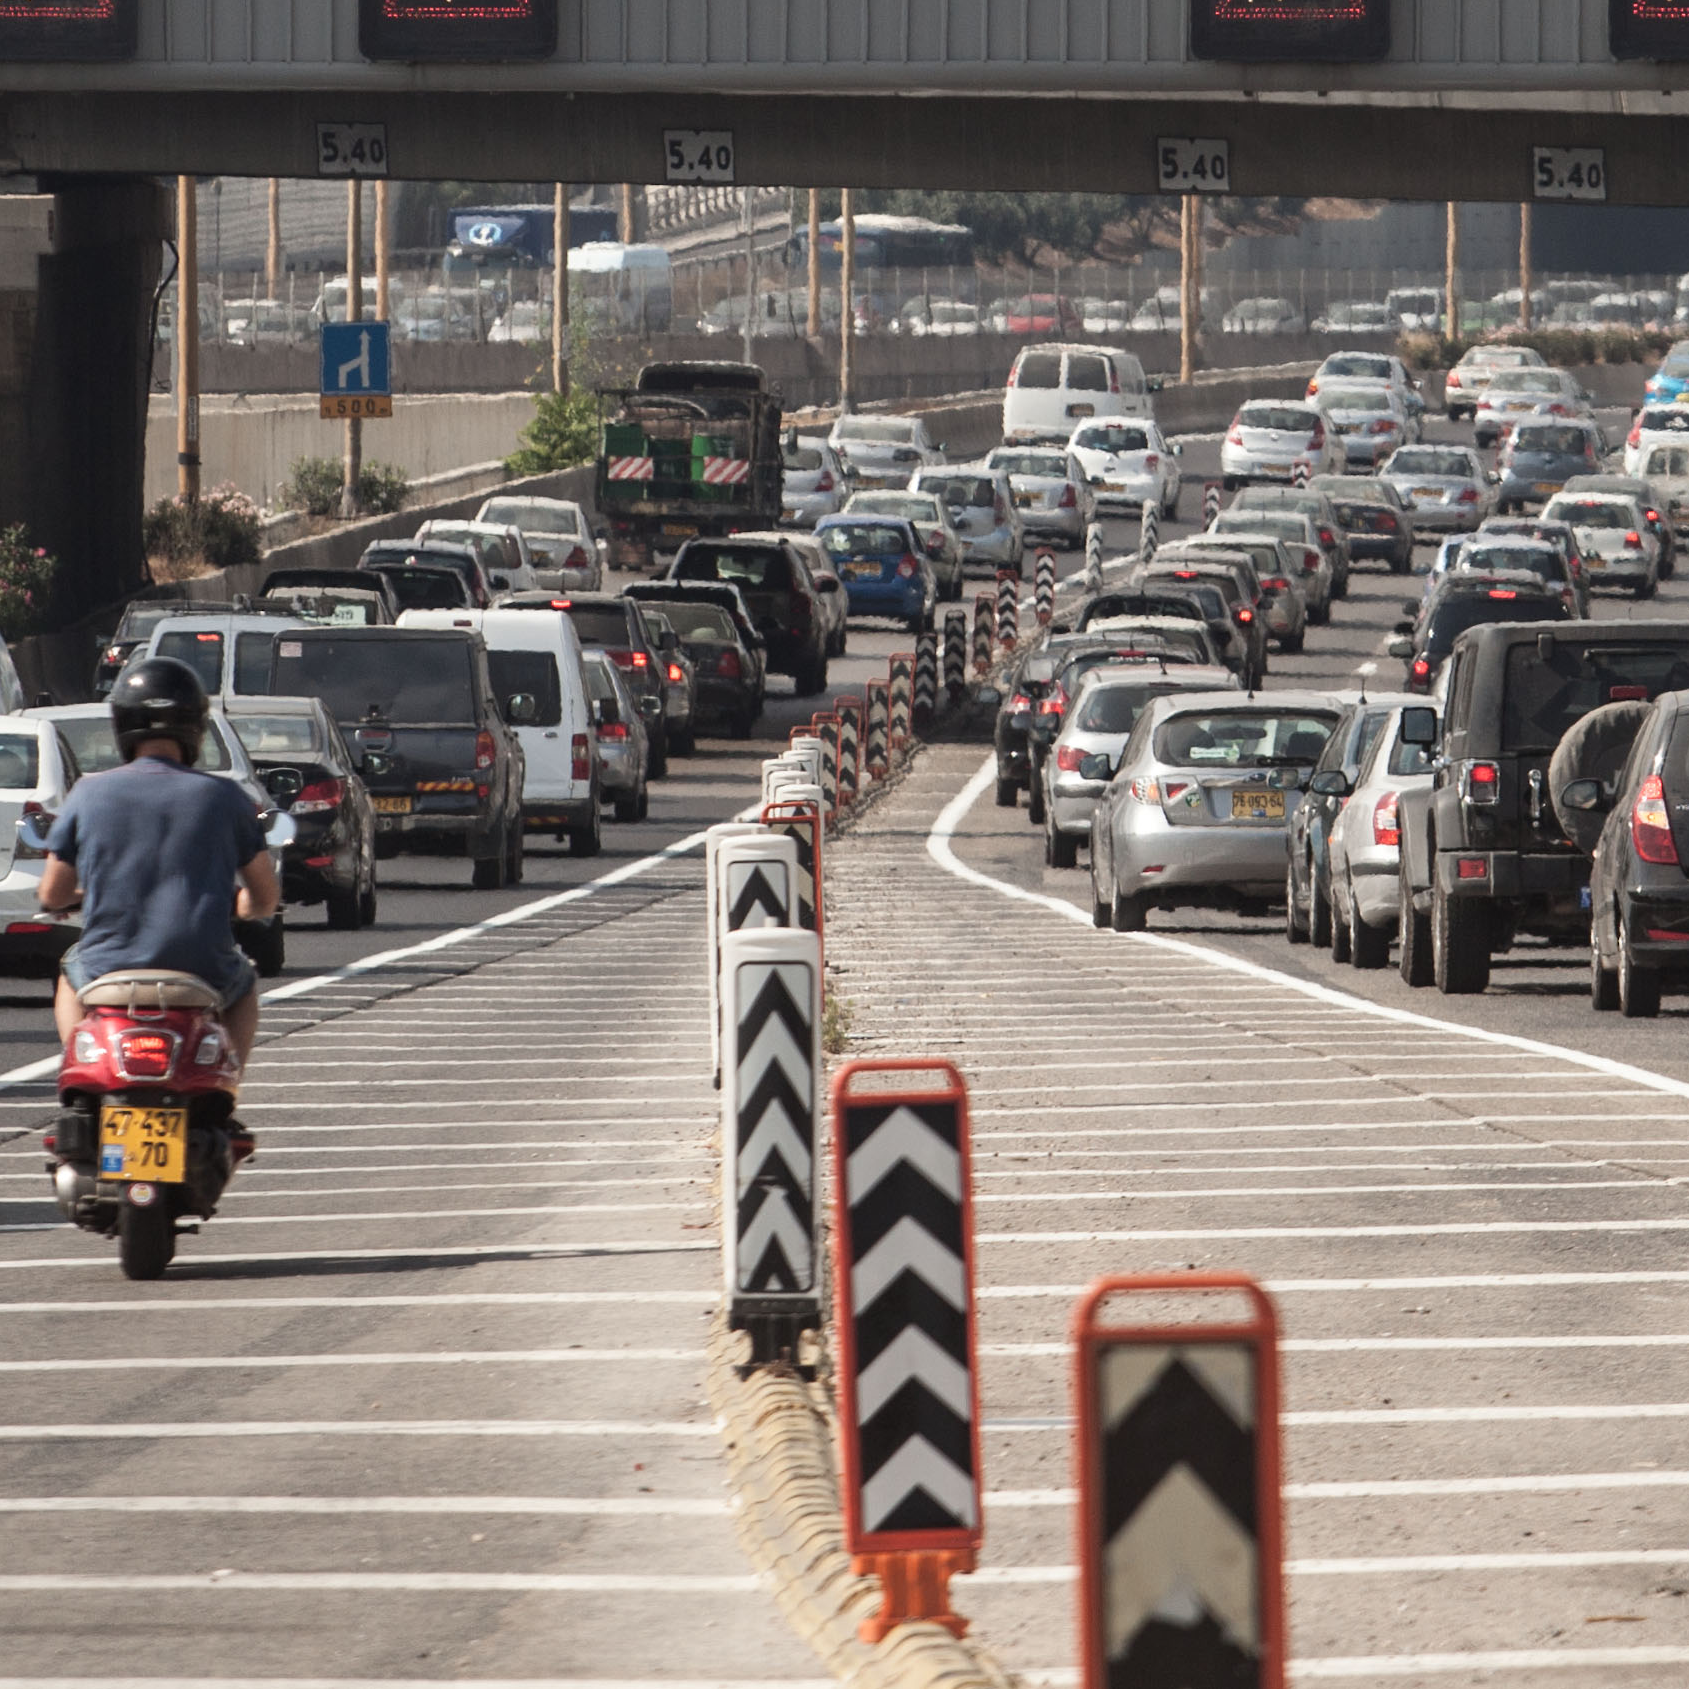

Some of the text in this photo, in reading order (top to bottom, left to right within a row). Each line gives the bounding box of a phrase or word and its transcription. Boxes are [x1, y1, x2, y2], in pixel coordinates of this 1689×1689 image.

[321, 131, 386, 164] 5.40
[669, 138, 731, 171] 5.40
[1161, 147, 1226, 180] 5.40
[1537, 157, 1601, 188] 5.40
[140, 1141, 169, 1168] 70
